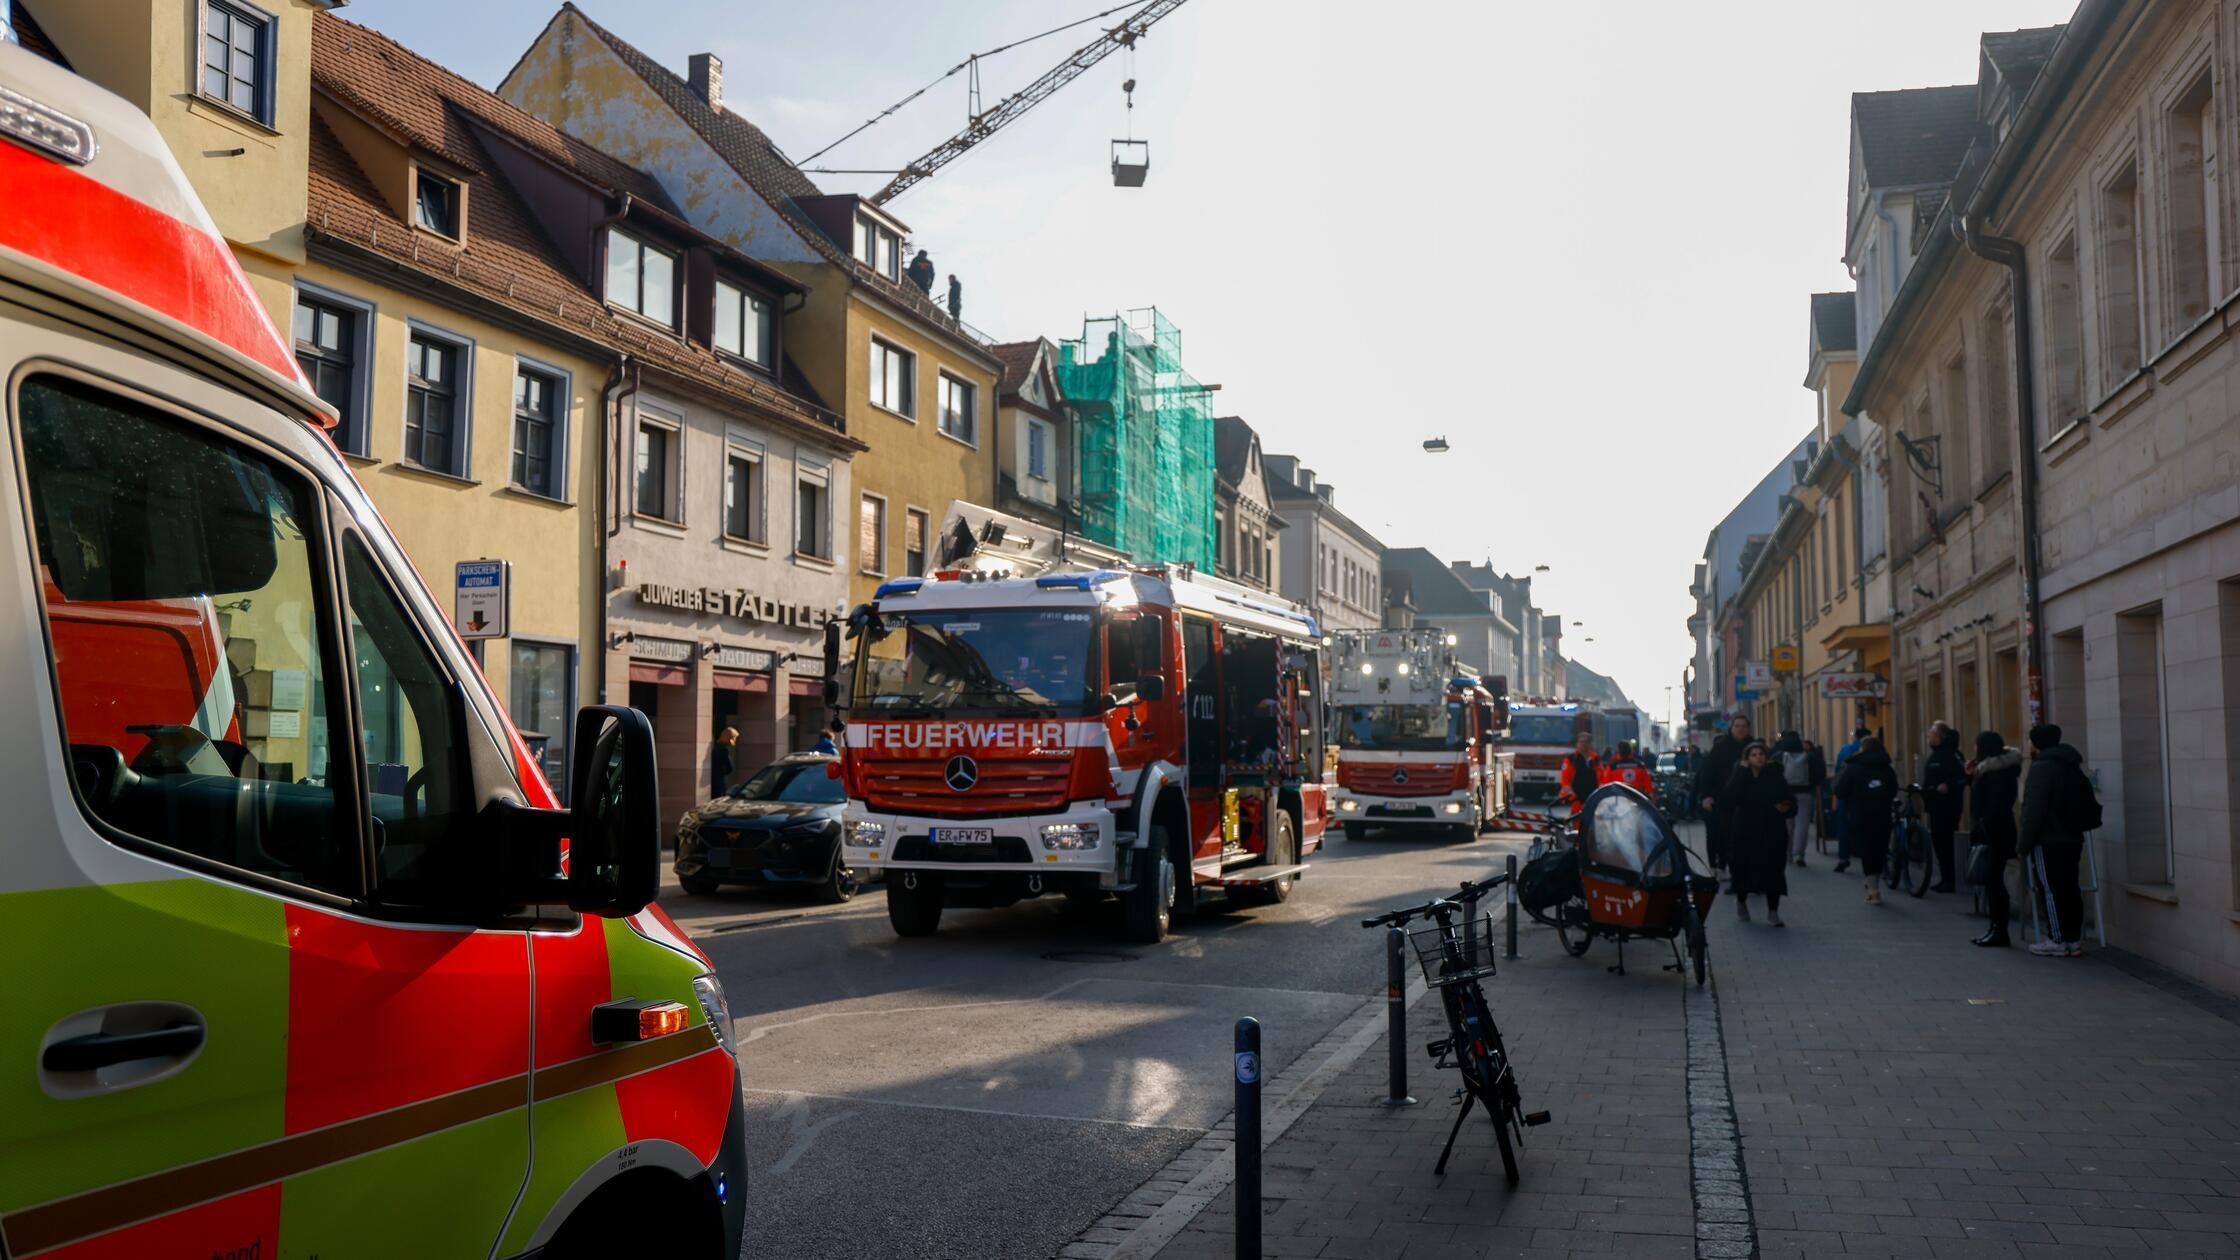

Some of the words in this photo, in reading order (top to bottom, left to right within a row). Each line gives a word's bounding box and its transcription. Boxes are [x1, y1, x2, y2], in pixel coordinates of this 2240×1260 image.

[458, 565, 499, 575] PARKSCHEIN-
[464, 576, 493, 586] AUTOMAT
[642, 584, 702, 611] JUWELIER
[1200, 695, 1215, 719] 112
[867, 723, 1063, 748] FEUERWEHR
